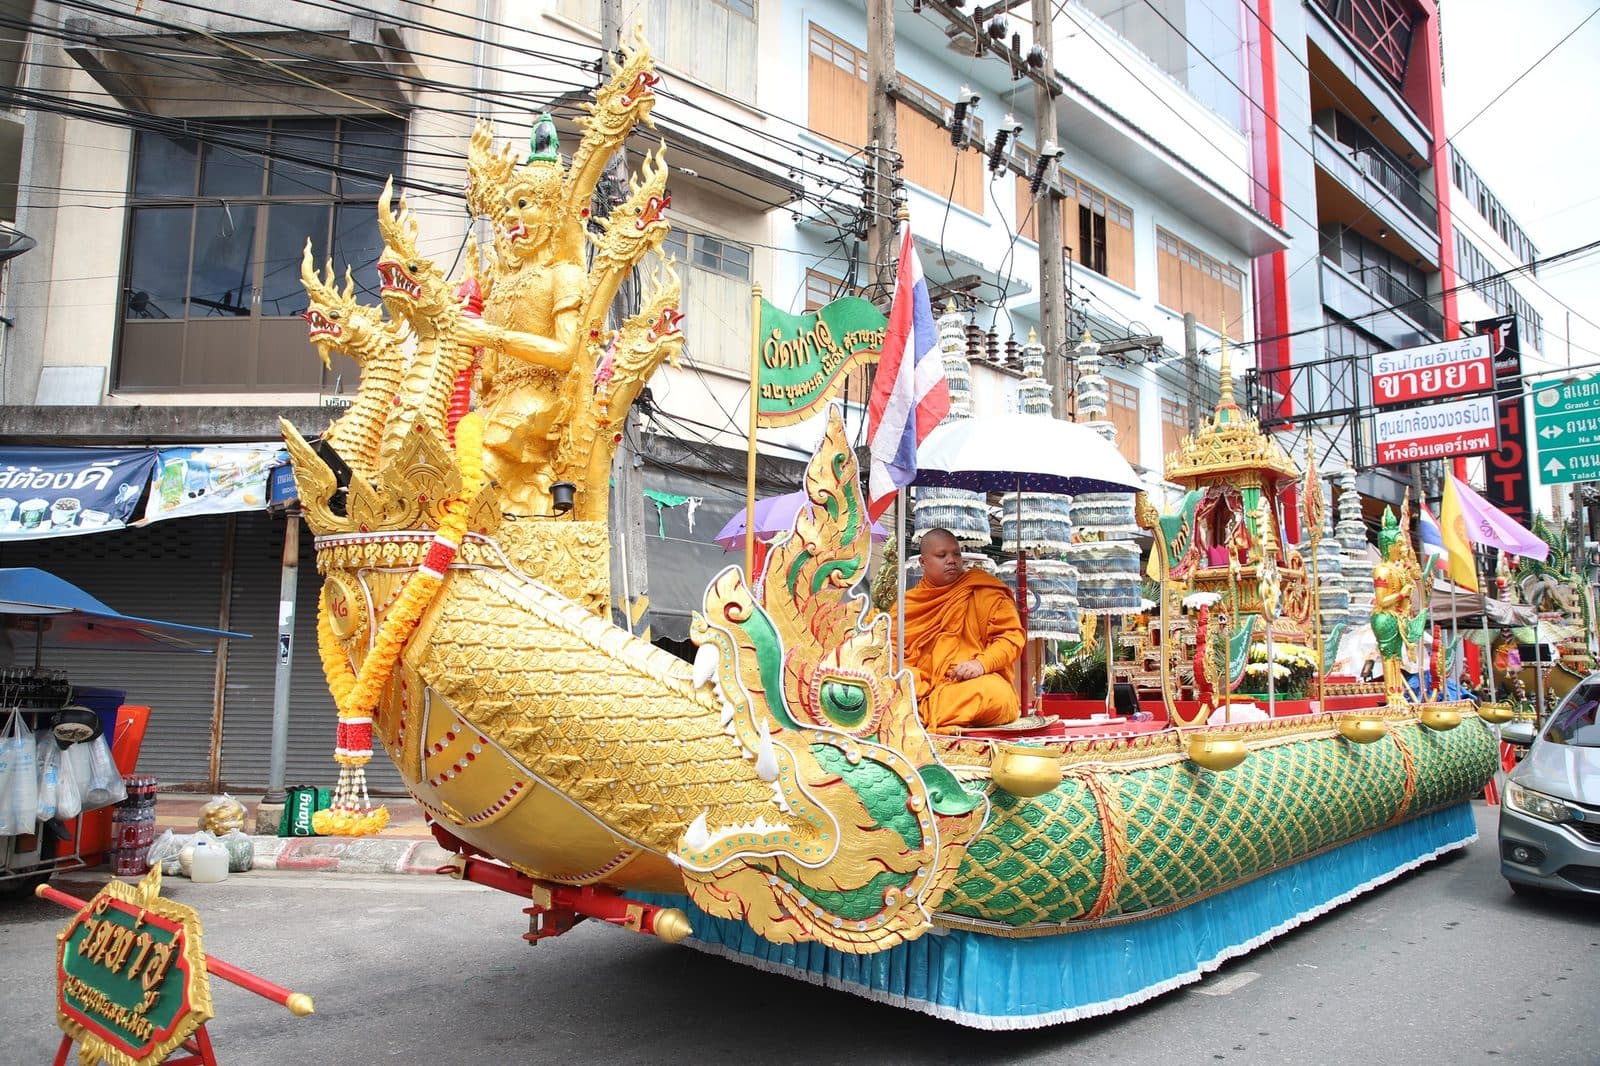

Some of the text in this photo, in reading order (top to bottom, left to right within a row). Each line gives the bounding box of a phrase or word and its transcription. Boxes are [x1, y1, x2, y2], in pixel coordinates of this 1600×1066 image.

[763, 310, 838, 369] วัดท่าอู่
[1378, 361, 1487, 398] ขายยา
[1380, 404, 1490, 441] ศูนย์กล้องวงจรปิด
[1564, 401, 1589, 410] Grand
[1383, 433, 1490, 461] ห้างอินเตอร์เซฟ
[1571, 471, 1596, 480] Talad
[294, 793, 313, 836] Chang
